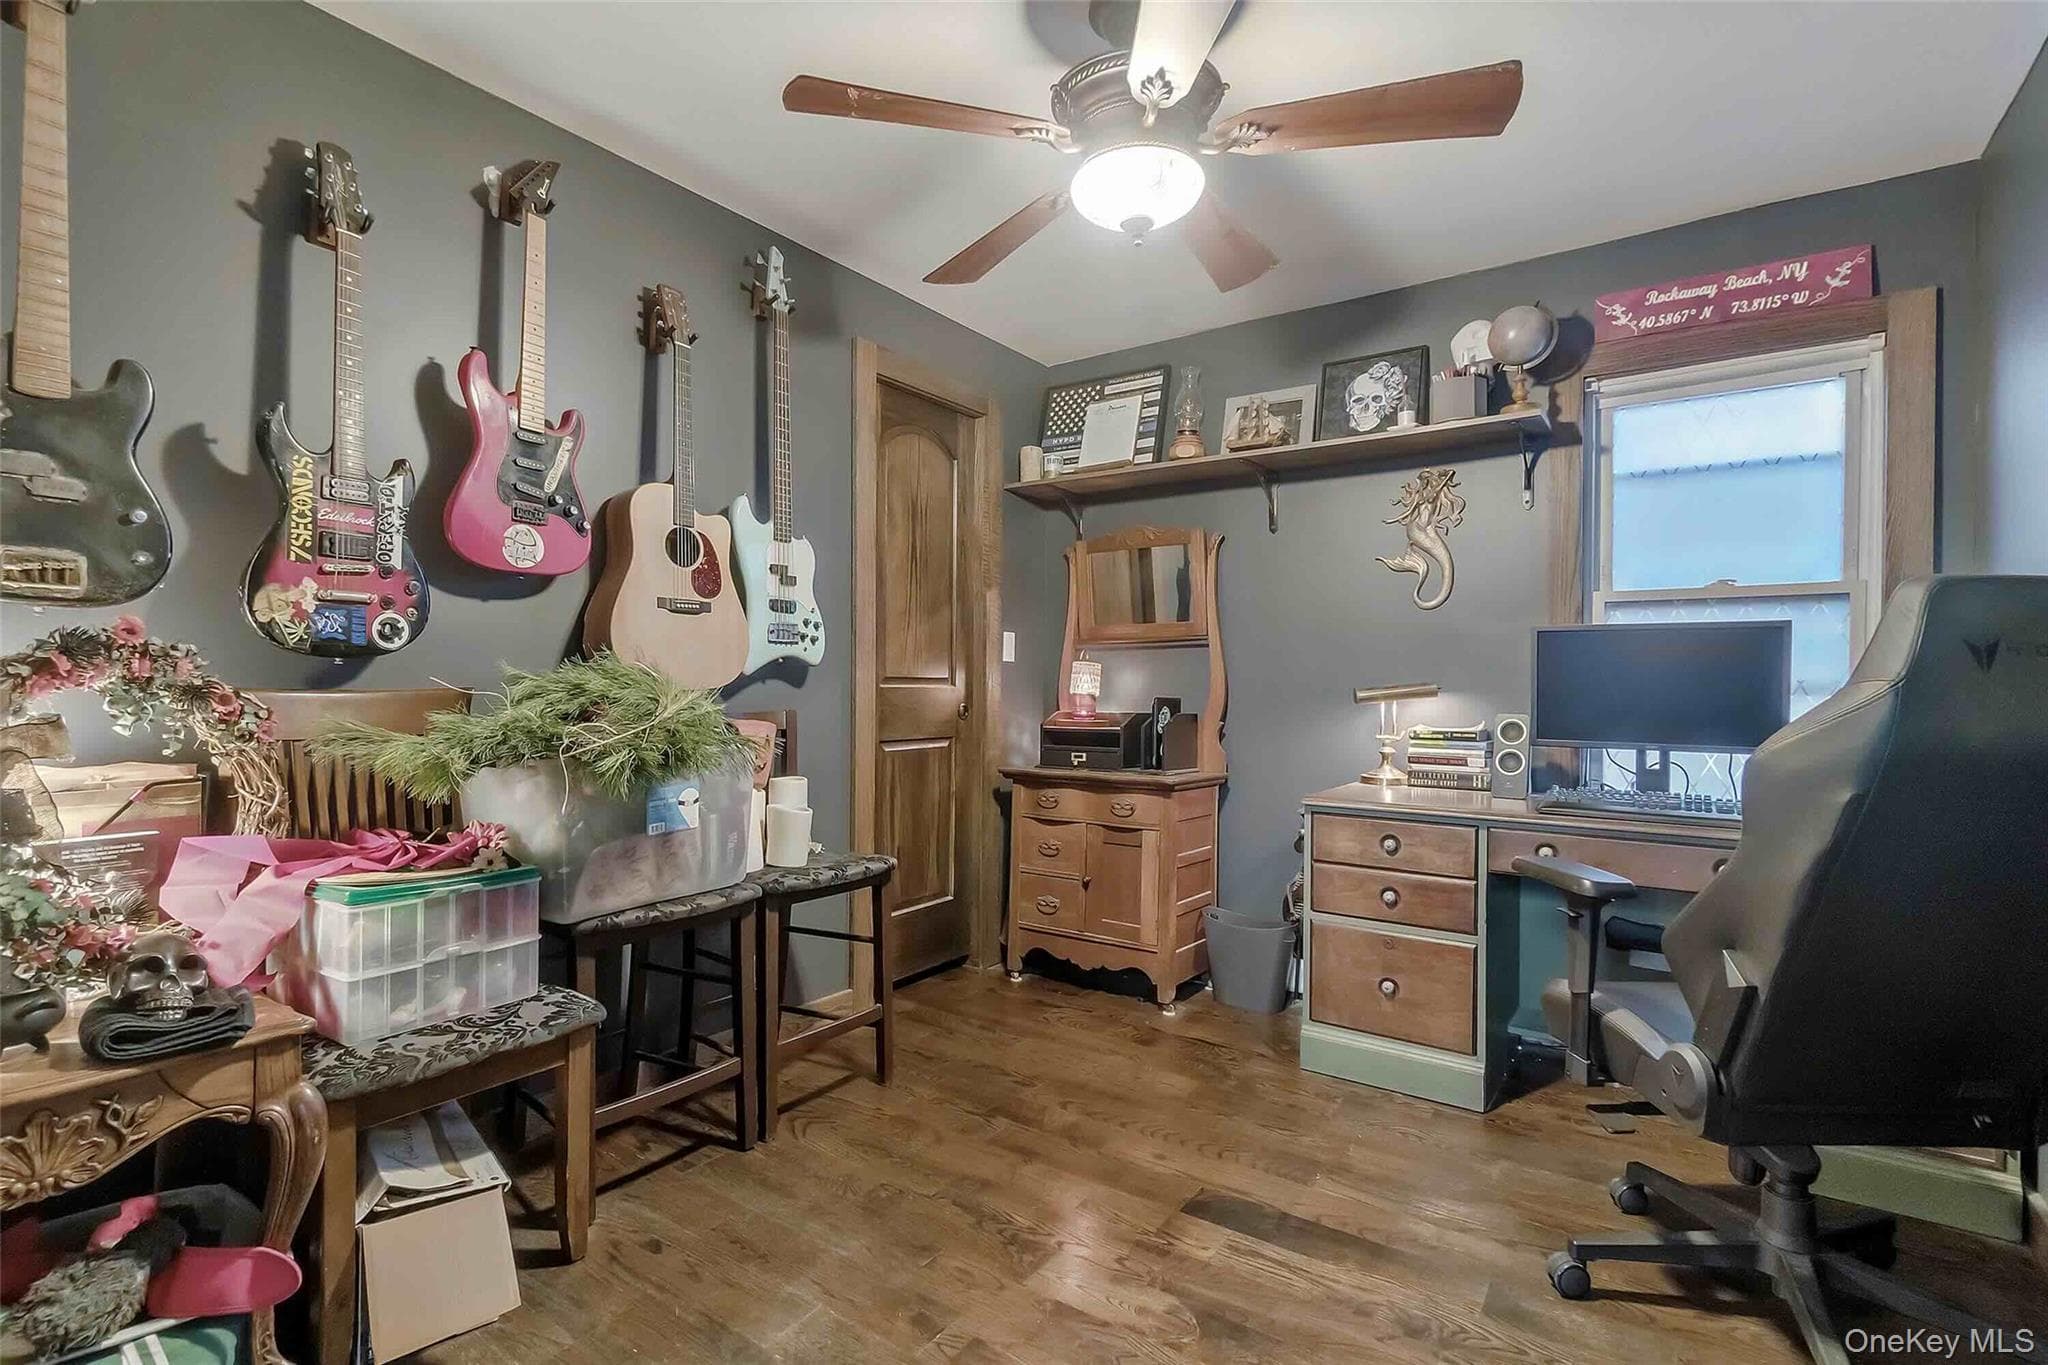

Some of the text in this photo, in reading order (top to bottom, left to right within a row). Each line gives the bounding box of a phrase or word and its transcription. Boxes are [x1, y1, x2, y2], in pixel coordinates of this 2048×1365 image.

[1645, 260, 1810, 306] Rockaway Beach, NY
[1699, 304, 1715, 320] N
[1790, 289, 1810, 304] W
